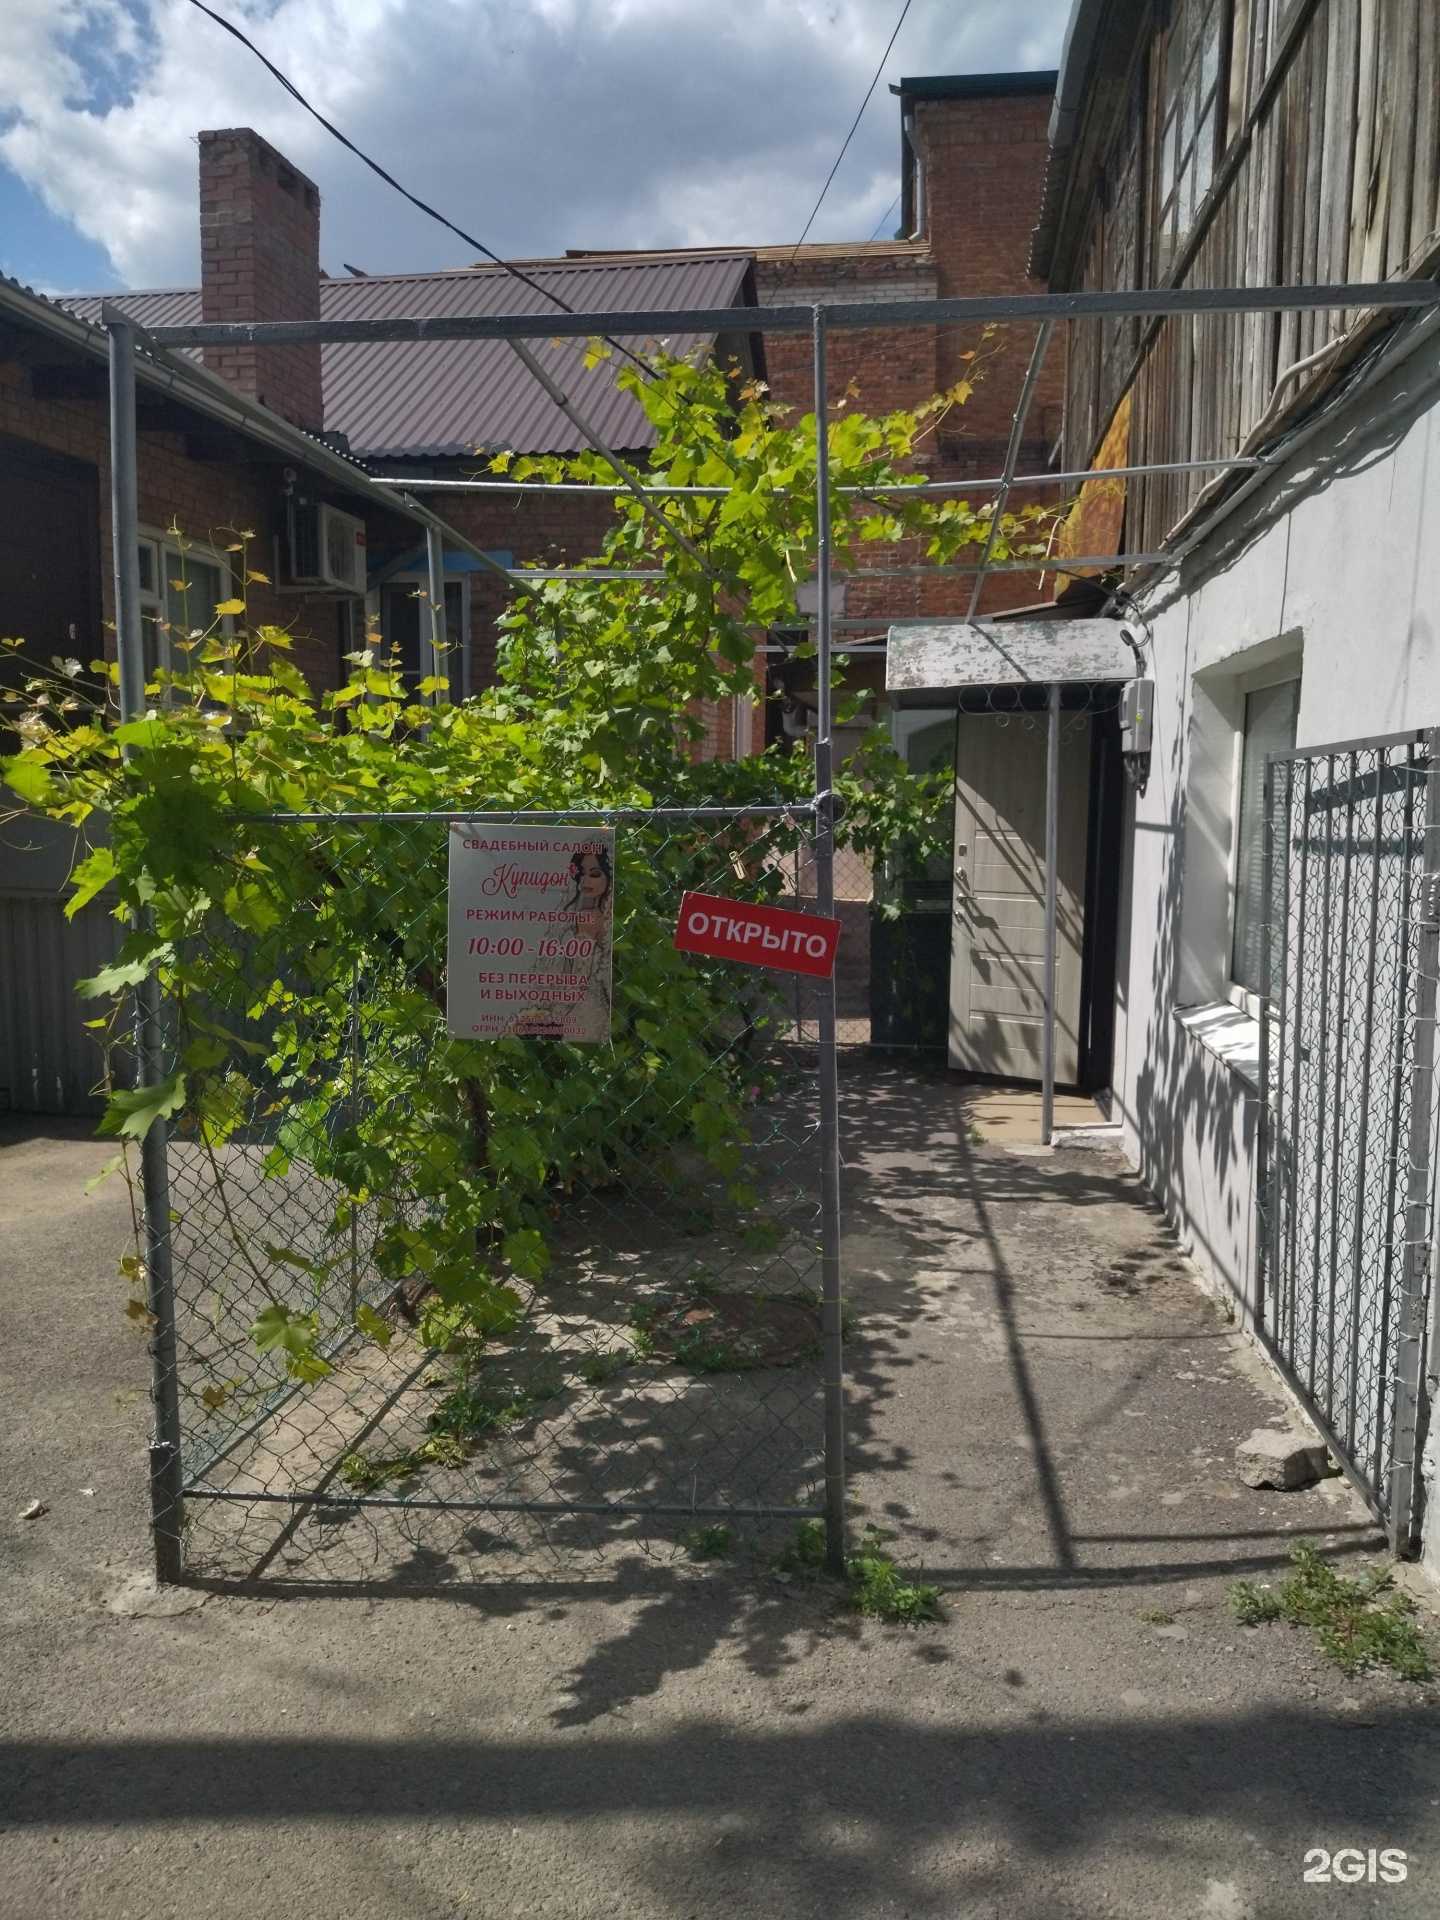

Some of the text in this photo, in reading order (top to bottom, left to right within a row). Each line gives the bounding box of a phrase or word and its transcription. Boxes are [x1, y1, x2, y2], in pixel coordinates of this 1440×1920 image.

[462, 839, 604, 854] СВАДЕБНЫЙ САЛОН
[481, 862, 569, 899] Купидон
[466, 909, 524, 921] РЕЖИМ
[687, 912, 828, 959] ОТКРЫТО
[468, 936, 524, 957] 10:00
[538, 938, 592, 958] 16:00
[479, 972, 588, 986] БЕЗ ПЕРЕРЫВА
[481, 989, 585, 1002] И ВЫХОДНЫХ
